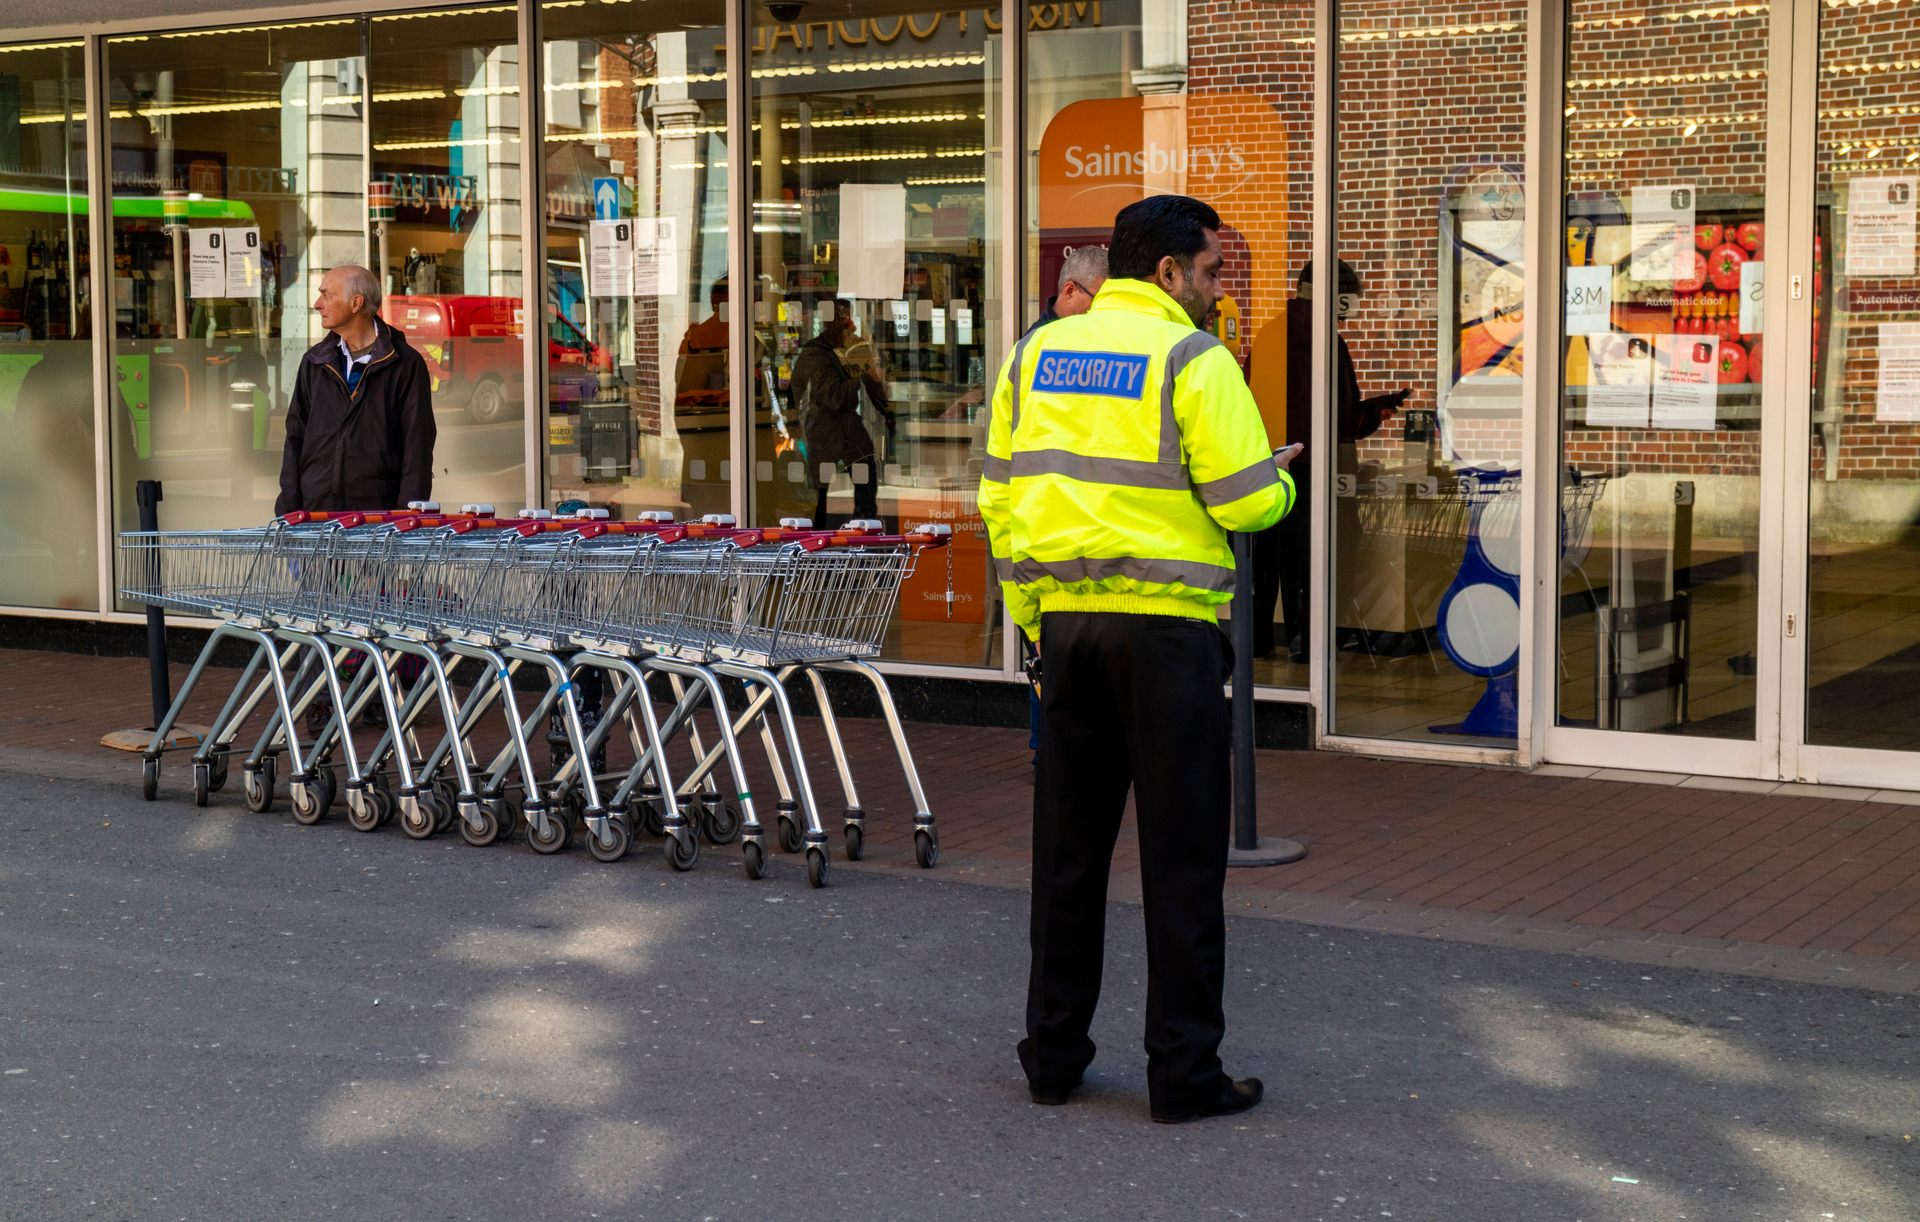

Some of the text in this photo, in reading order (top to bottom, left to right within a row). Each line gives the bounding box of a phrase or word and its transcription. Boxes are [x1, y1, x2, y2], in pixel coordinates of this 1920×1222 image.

[1065, 139, 1245, 180] Sainsbury's
[801, 187, 840, 198] Fizzy drin
[546, 185, 596, 223] pirit
[1646, 295, 1724, 306] Automatic door
[1856, 294, 1914, 305] Automatic
[1494, 307, 1524, 324] NO
[1040, 356, 1142, 391] SECURITY
[929, 509, 955, 519] Food
[923, 591, 972, 604] Sainsury's
